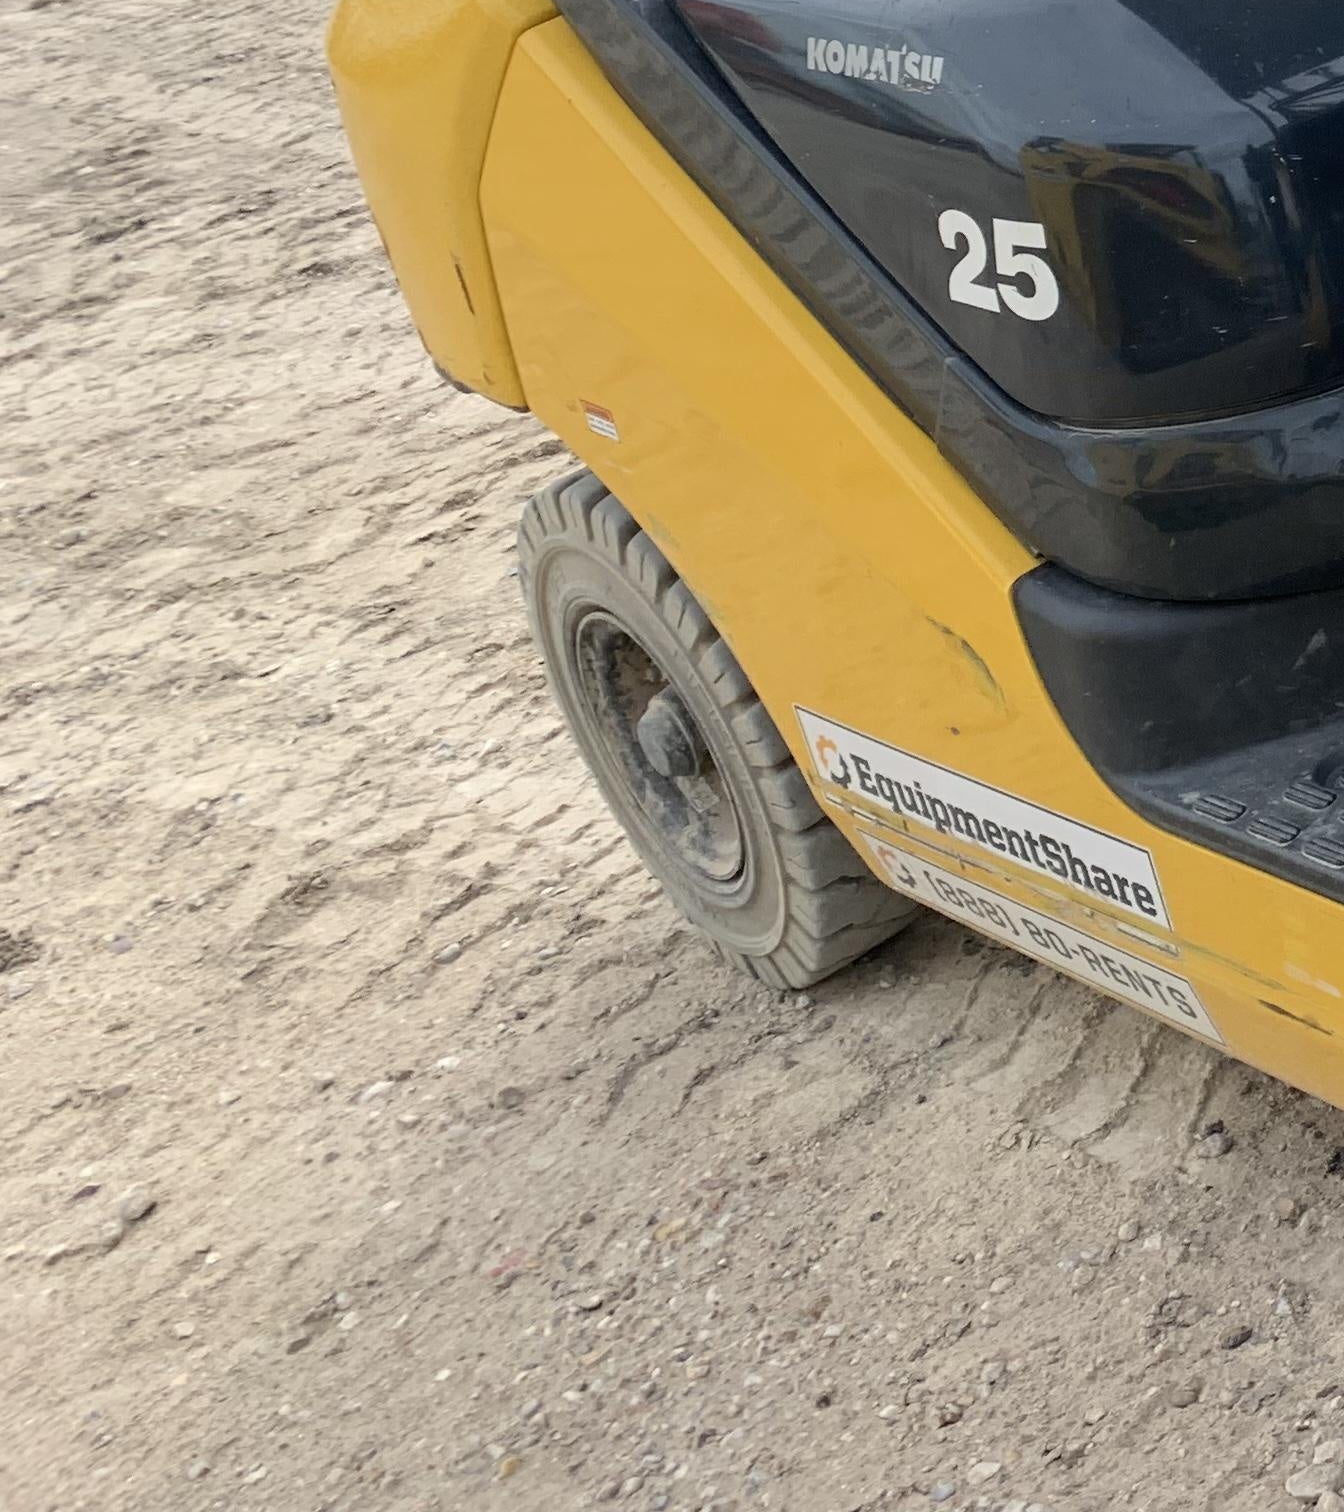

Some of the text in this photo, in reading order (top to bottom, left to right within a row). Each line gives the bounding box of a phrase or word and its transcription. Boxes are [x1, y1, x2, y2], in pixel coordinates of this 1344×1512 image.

[806, 37, 944, 89] KOMATSU
[937, 208, 1060, 322] 25
[850, 753, 1158, 918] EquipmentShare
[923, 869, 1199, 1020] (888) 80-RENTS
